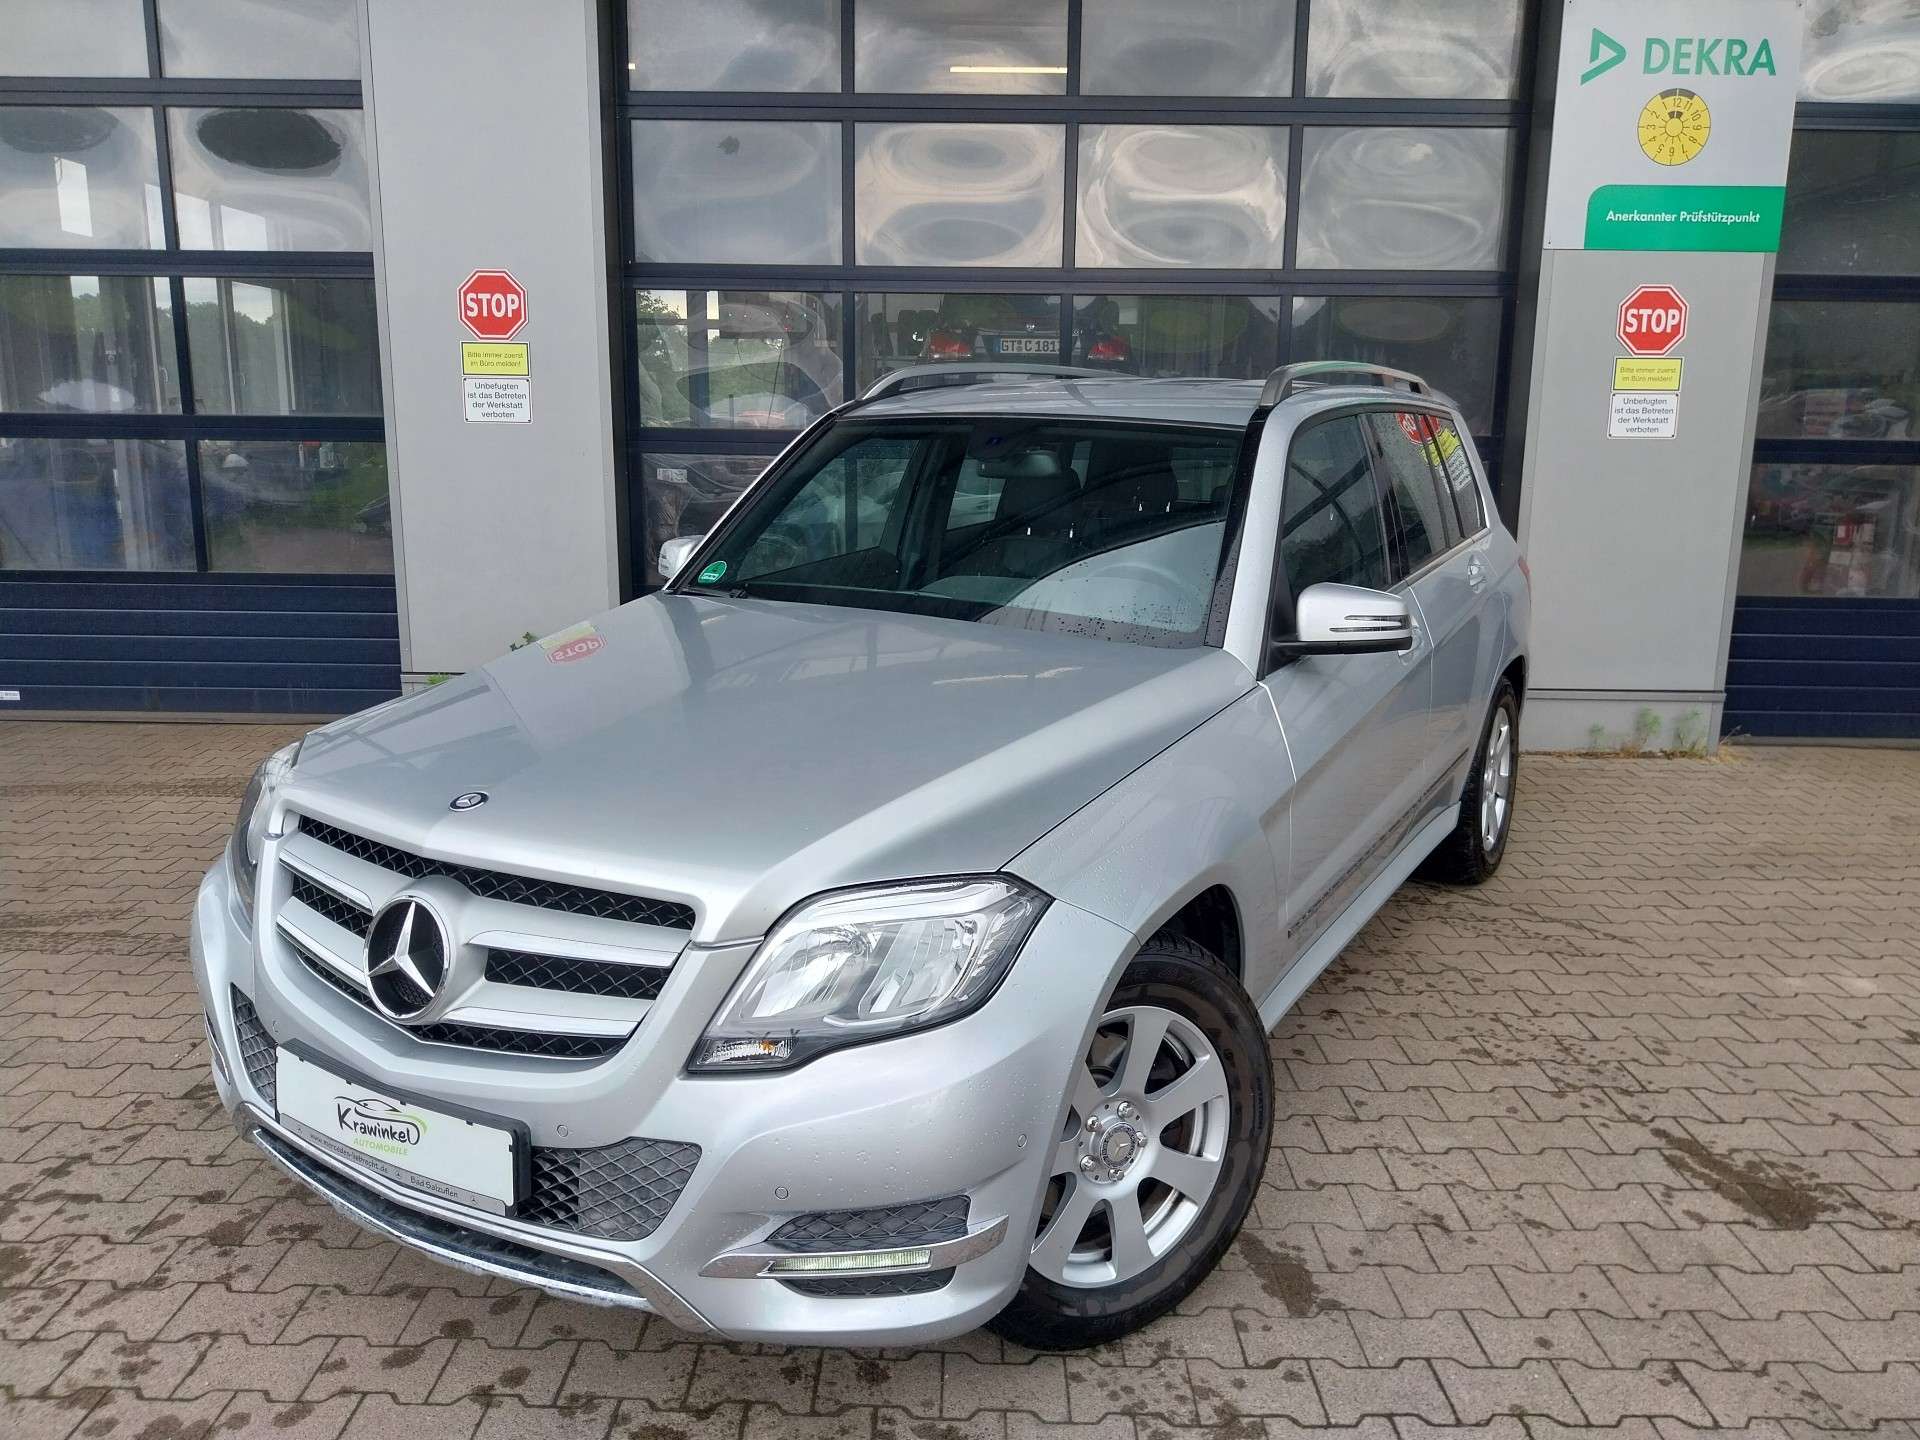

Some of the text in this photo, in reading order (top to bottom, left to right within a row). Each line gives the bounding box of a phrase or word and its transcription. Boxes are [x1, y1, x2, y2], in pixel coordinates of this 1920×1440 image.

[1642, 37, 1777, 76] DEKRA
[1673, 98, 1682, 108] 12
[1683, 100, 1693, 111] 11
[1650, 110, 1660, 119] 2
[1690, 109, 1701, 122] 10
[1688, 135, 1698, 144] 8
[1656, 143, 1665, 153] 5
[1606, 209, 1761, 225] Anerkannter Prüfstützpunkt
[466, 292, 520, 318] STOP
[1625, 308, 1681, 334] STOP
[1001, 340, 1017, 352] GT
[1024, 340, 1033, 352] C
[467, 351, 482, 359] Bitte
[479, 359, 495, 367] Büro
[495, 360, 521, 368] melden!
[1631, 374, 1647, 382] Büro
[474, 381, 519, 392] Unbefugten
[467, 391, 527, 400] ist das Betreten
[472, 401, 523, 409] der Werkstatt
[1623, 397, 1668, 408] Unbefugten
[481, 410, 515, 419] verboten
[1614, 407, 1674, 415] ist das Betreten
[1632, 416, 1669, 424] Werkstatt
[1625, 426, 1659, 434] verboten
[337, 1103, 421, 1146] Krawinkel
[353, 1138, 408, 1156] AUTOMOBILE
[410, 1175, 458, 1197] Bad Salzuflen
